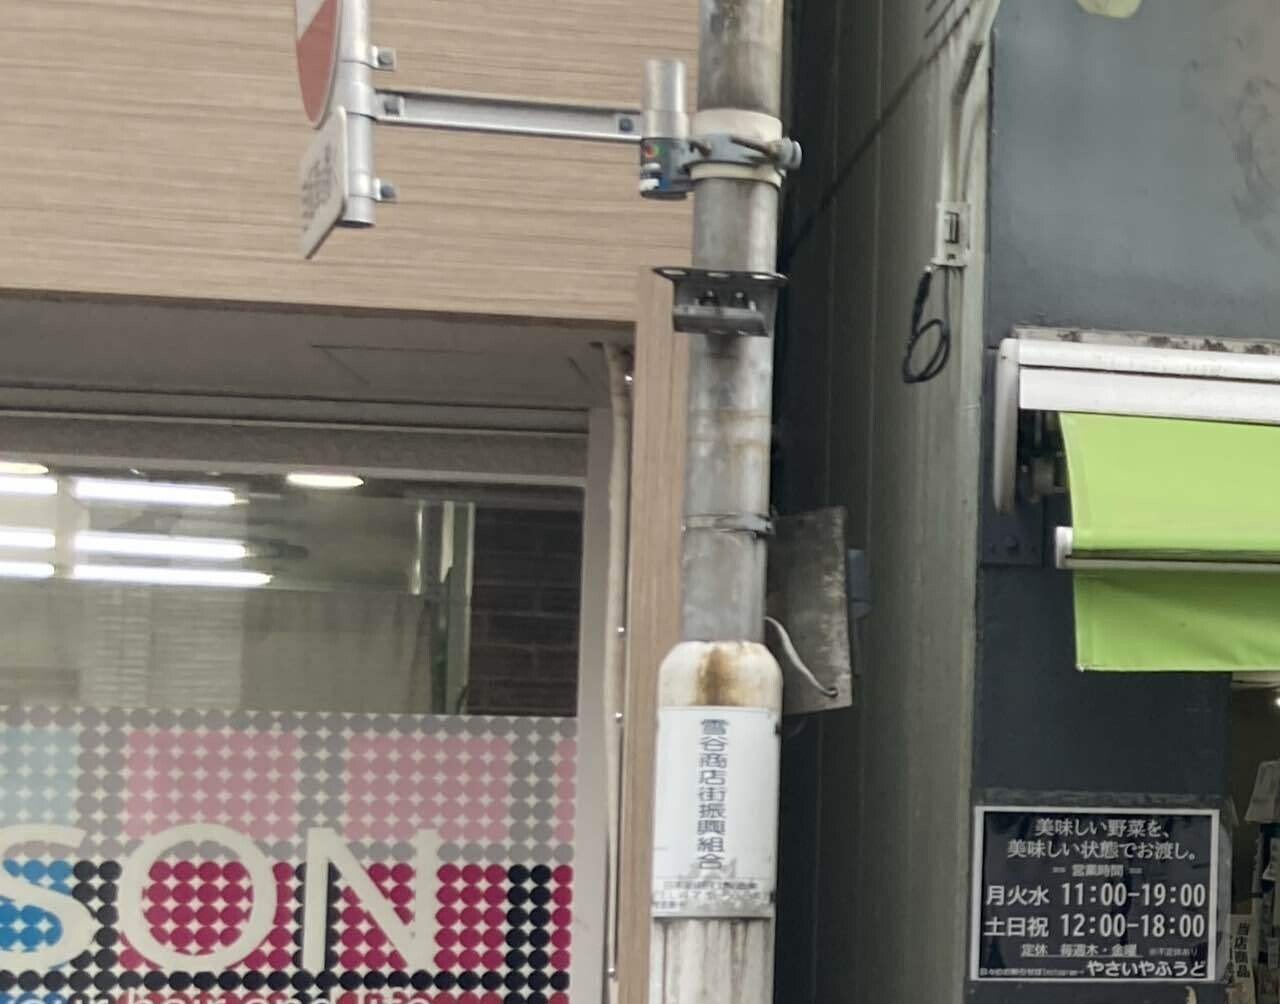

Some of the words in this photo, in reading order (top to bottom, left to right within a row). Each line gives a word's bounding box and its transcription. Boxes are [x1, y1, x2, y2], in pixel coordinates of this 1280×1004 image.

[696, 718, 731, 870] 雪谷商店街振興組合
[1035, 818, 1170, 839] 美味しい野菜を、
[1007, 839, 1196, 861] 美味しい状態でお渡し。
[1071, 863, 1124, 878] 営業時間
[986, 885, 1049, 906] 月火水
[1061, 882, 1206, 907] 11:00-19:00
[984, 916, 1049, 938] 土日祝
[1060, 913, 1205, 938] 12:00-18:00
[1087, 960, 1207, 978] やさいやふうど
